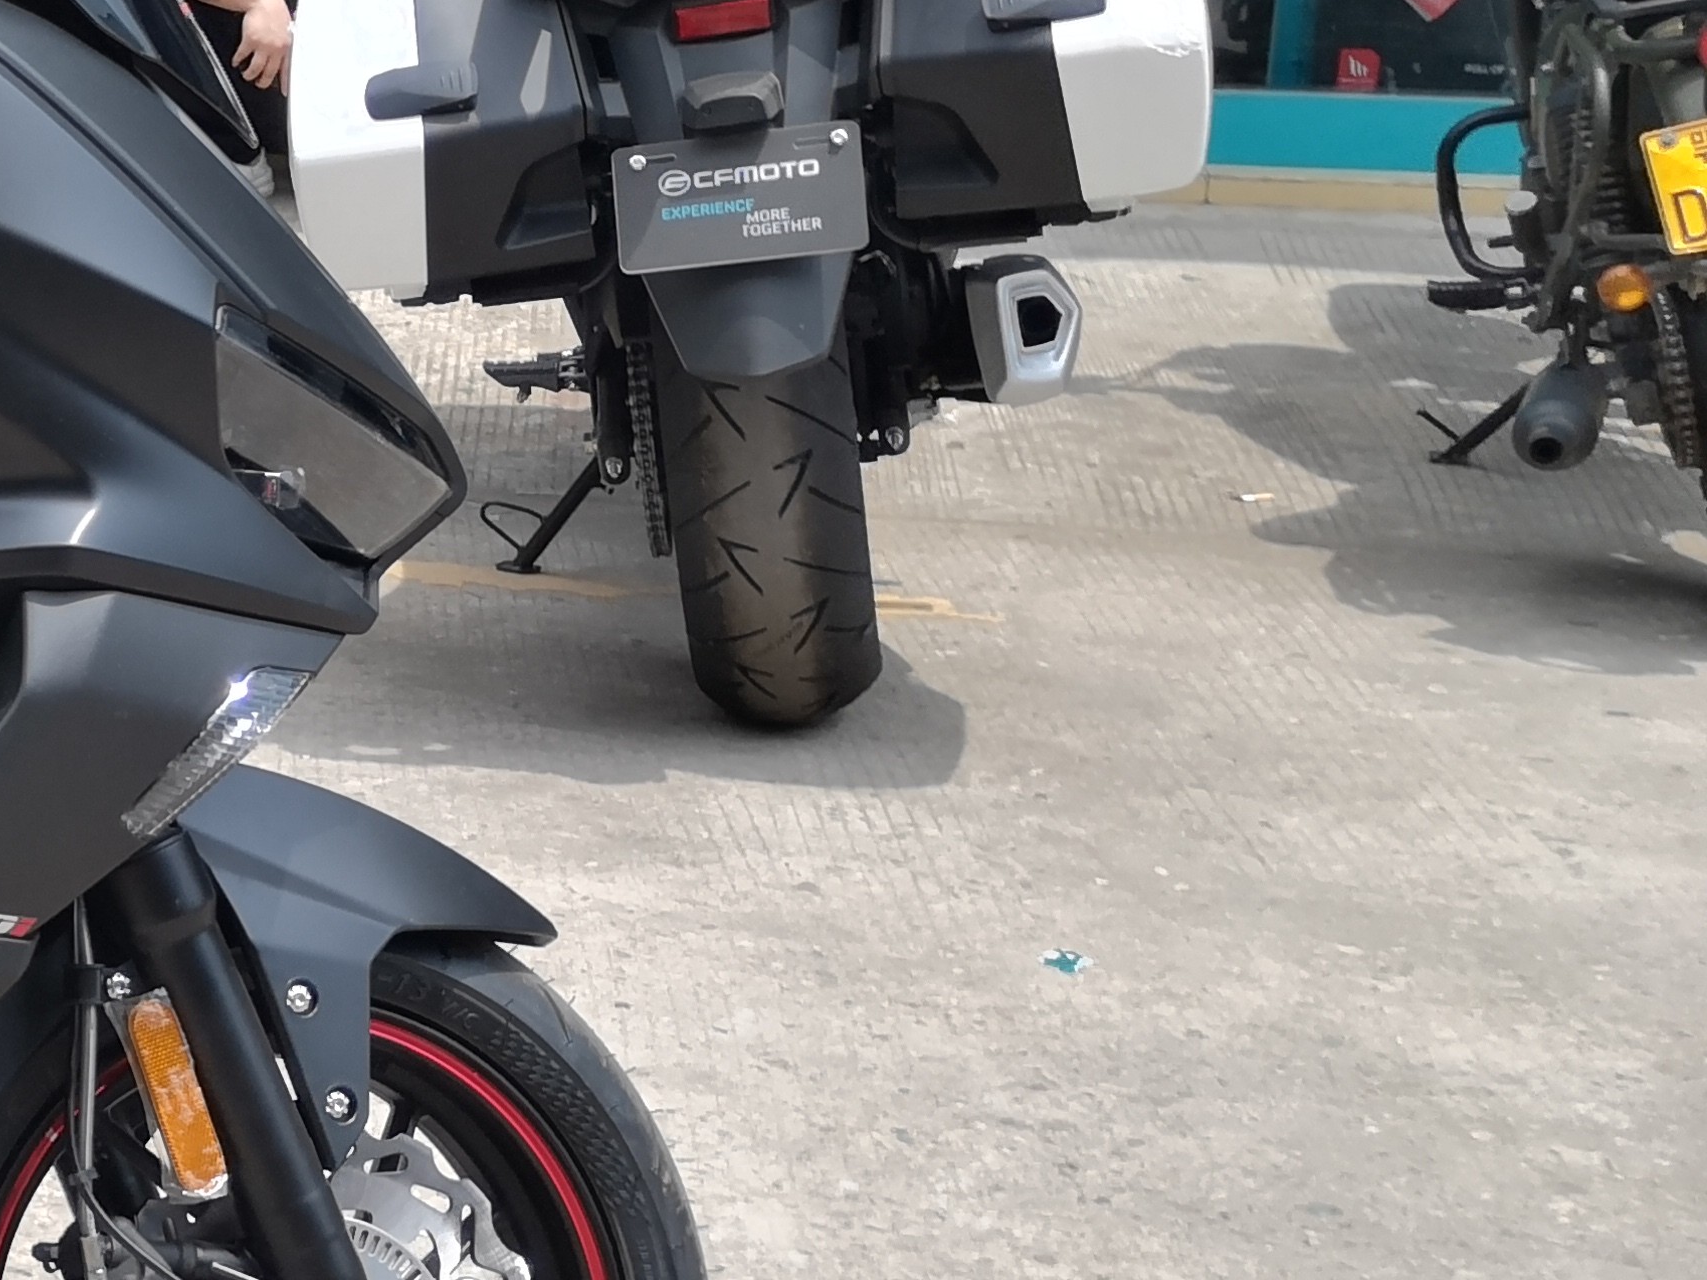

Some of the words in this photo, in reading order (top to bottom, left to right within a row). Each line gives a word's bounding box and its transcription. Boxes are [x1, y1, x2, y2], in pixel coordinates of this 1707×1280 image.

[693, 158, 820, 189] CFMOTO
[661, 198, 755, 221] EXPERIENCE
[745, 207, 791, 224] MORE
[742, 216, 822, 238] TOGETHER
